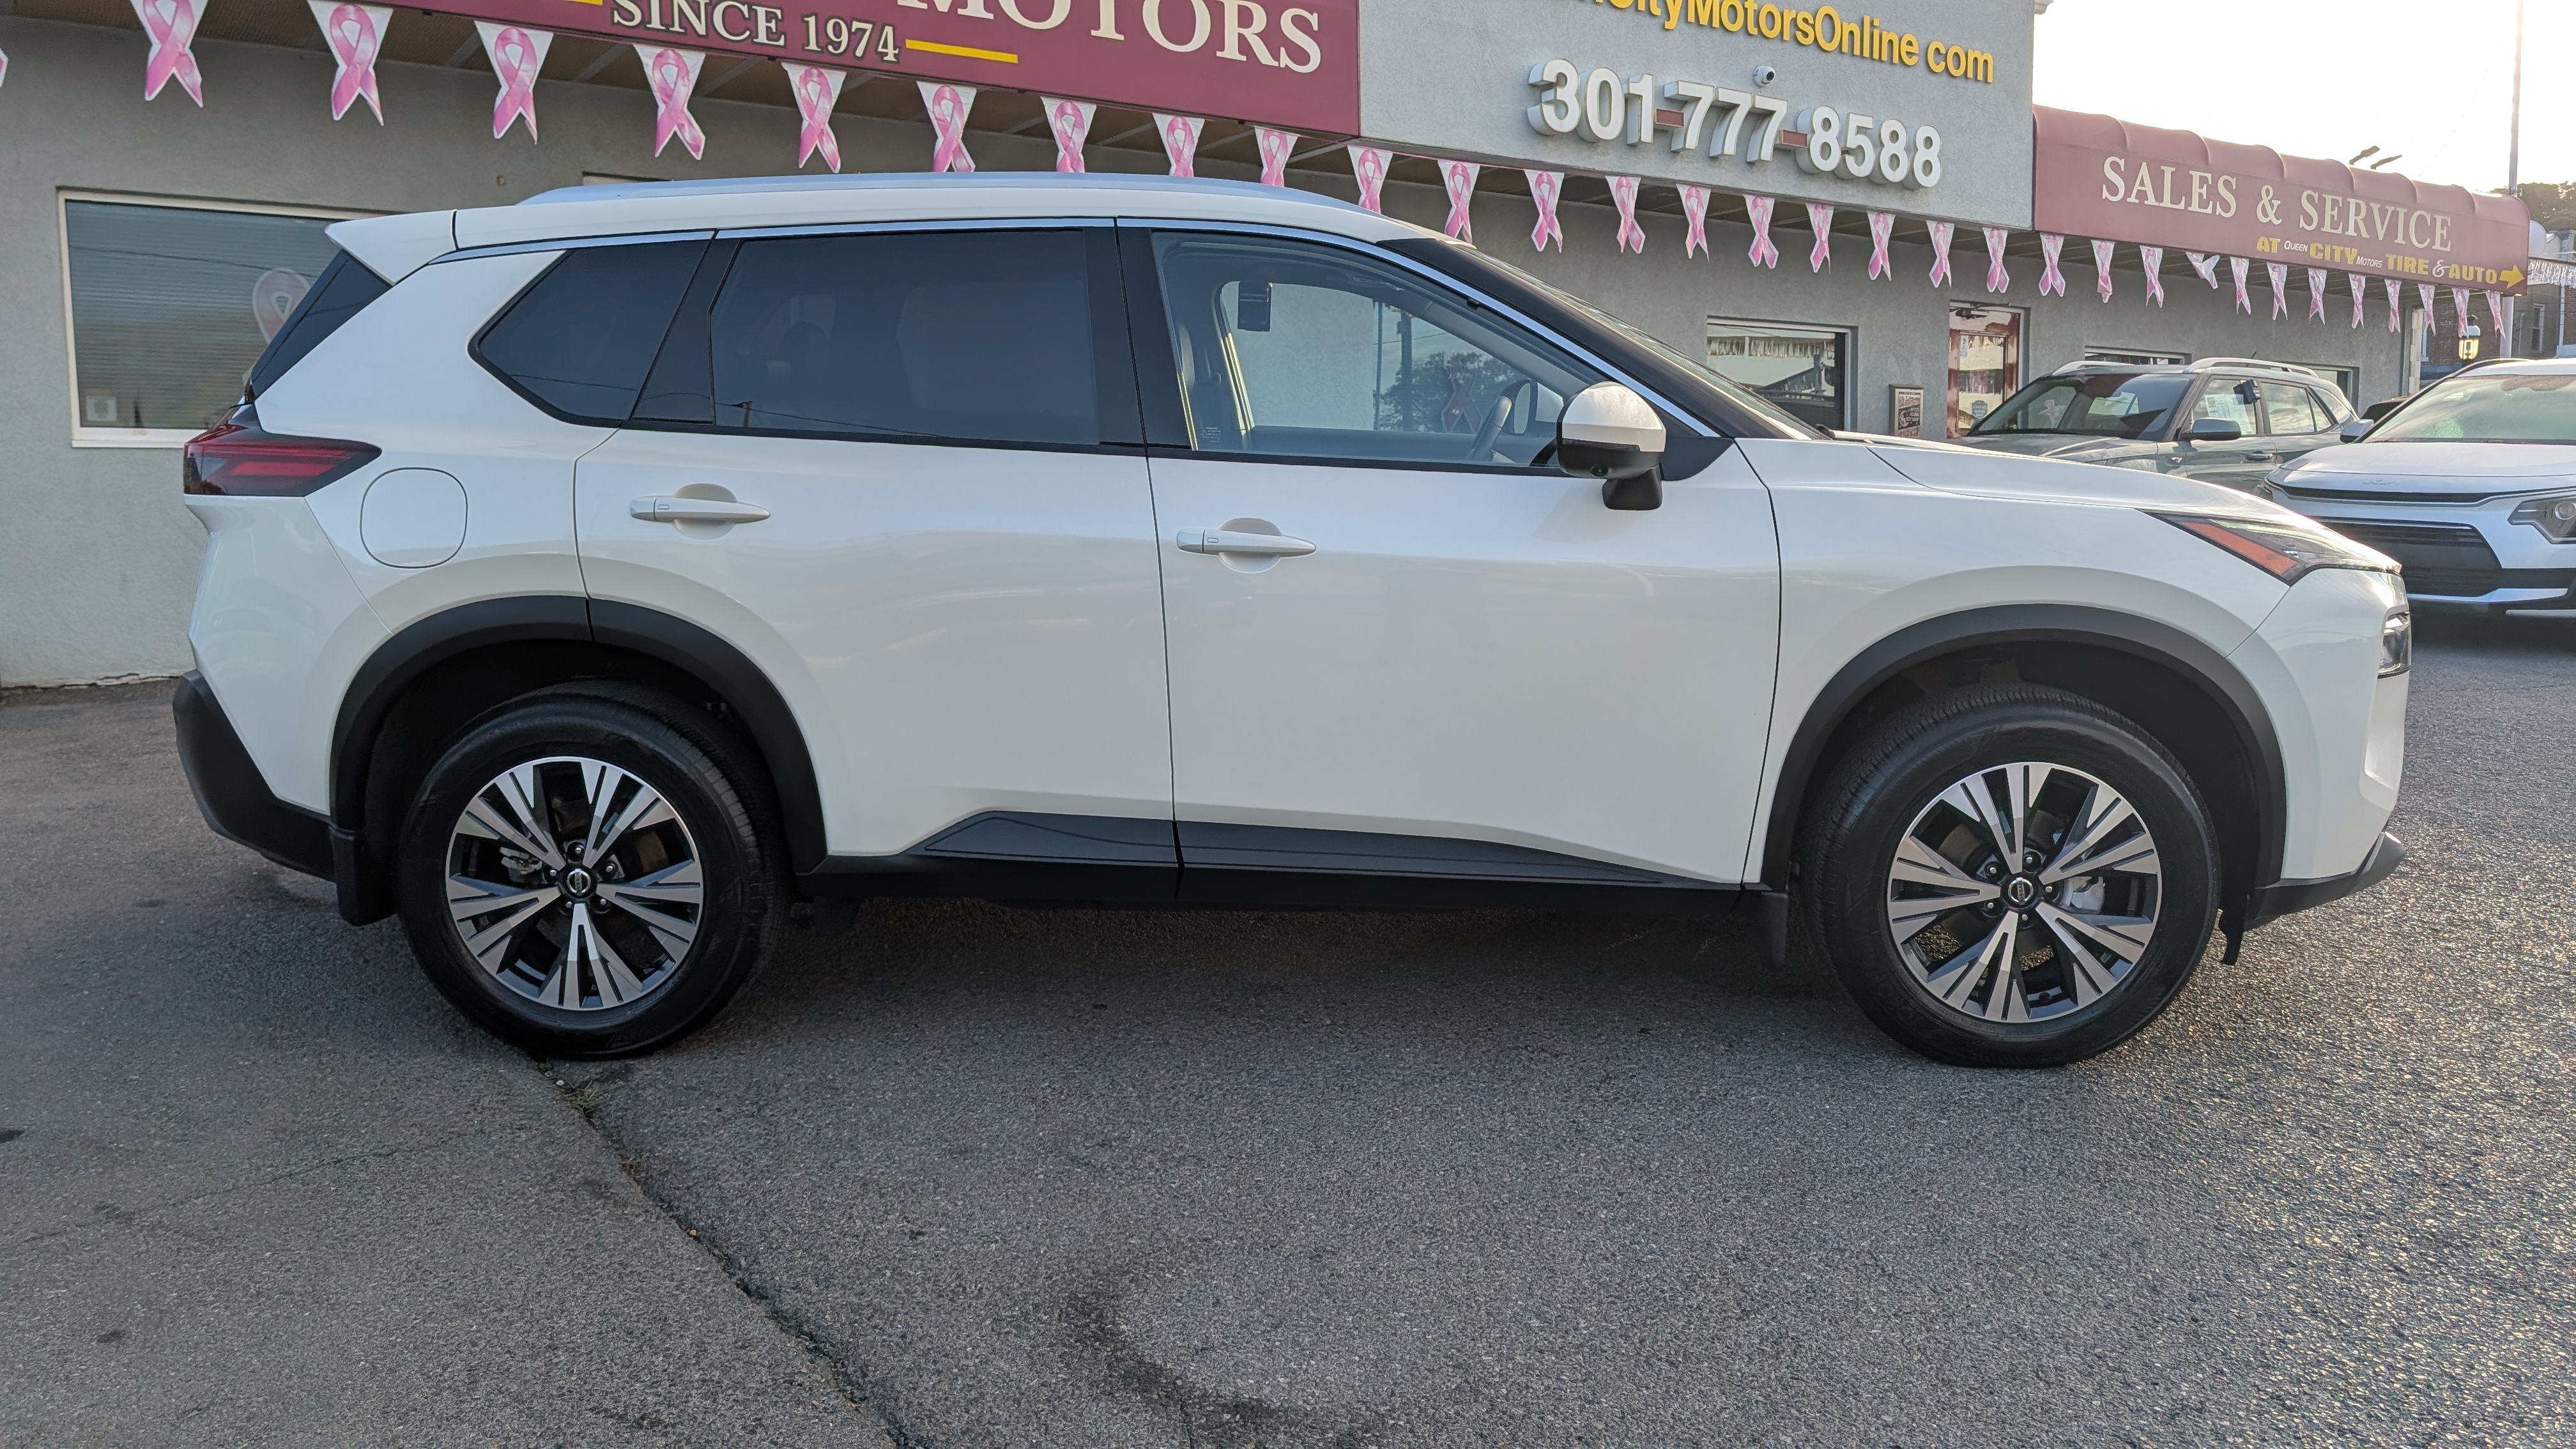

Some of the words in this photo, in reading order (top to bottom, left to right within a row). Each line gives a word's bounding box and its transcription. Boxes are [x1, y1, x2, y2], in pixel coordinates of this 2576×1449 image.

[613, 0, 785, 47] SINCE
[802, 14, 900, 63] 1974
[2102, 156, 2236, 218] SALES
[2257, 185, 2282, 225] &
[2299, 190, 2451, 252] SERVICE
[2256, 236, 2281, 254] AT
[2284, 240, 2308, 252] QUEEN
[2309, 242, 2358, 264] CITY
[2356, 256, 2383, 268] MOTORS
[2386, 253, 2429, 275] TIRE
[2432, 259, 2451, 278] &
[2448, 263, 2497, 284] AUTO
